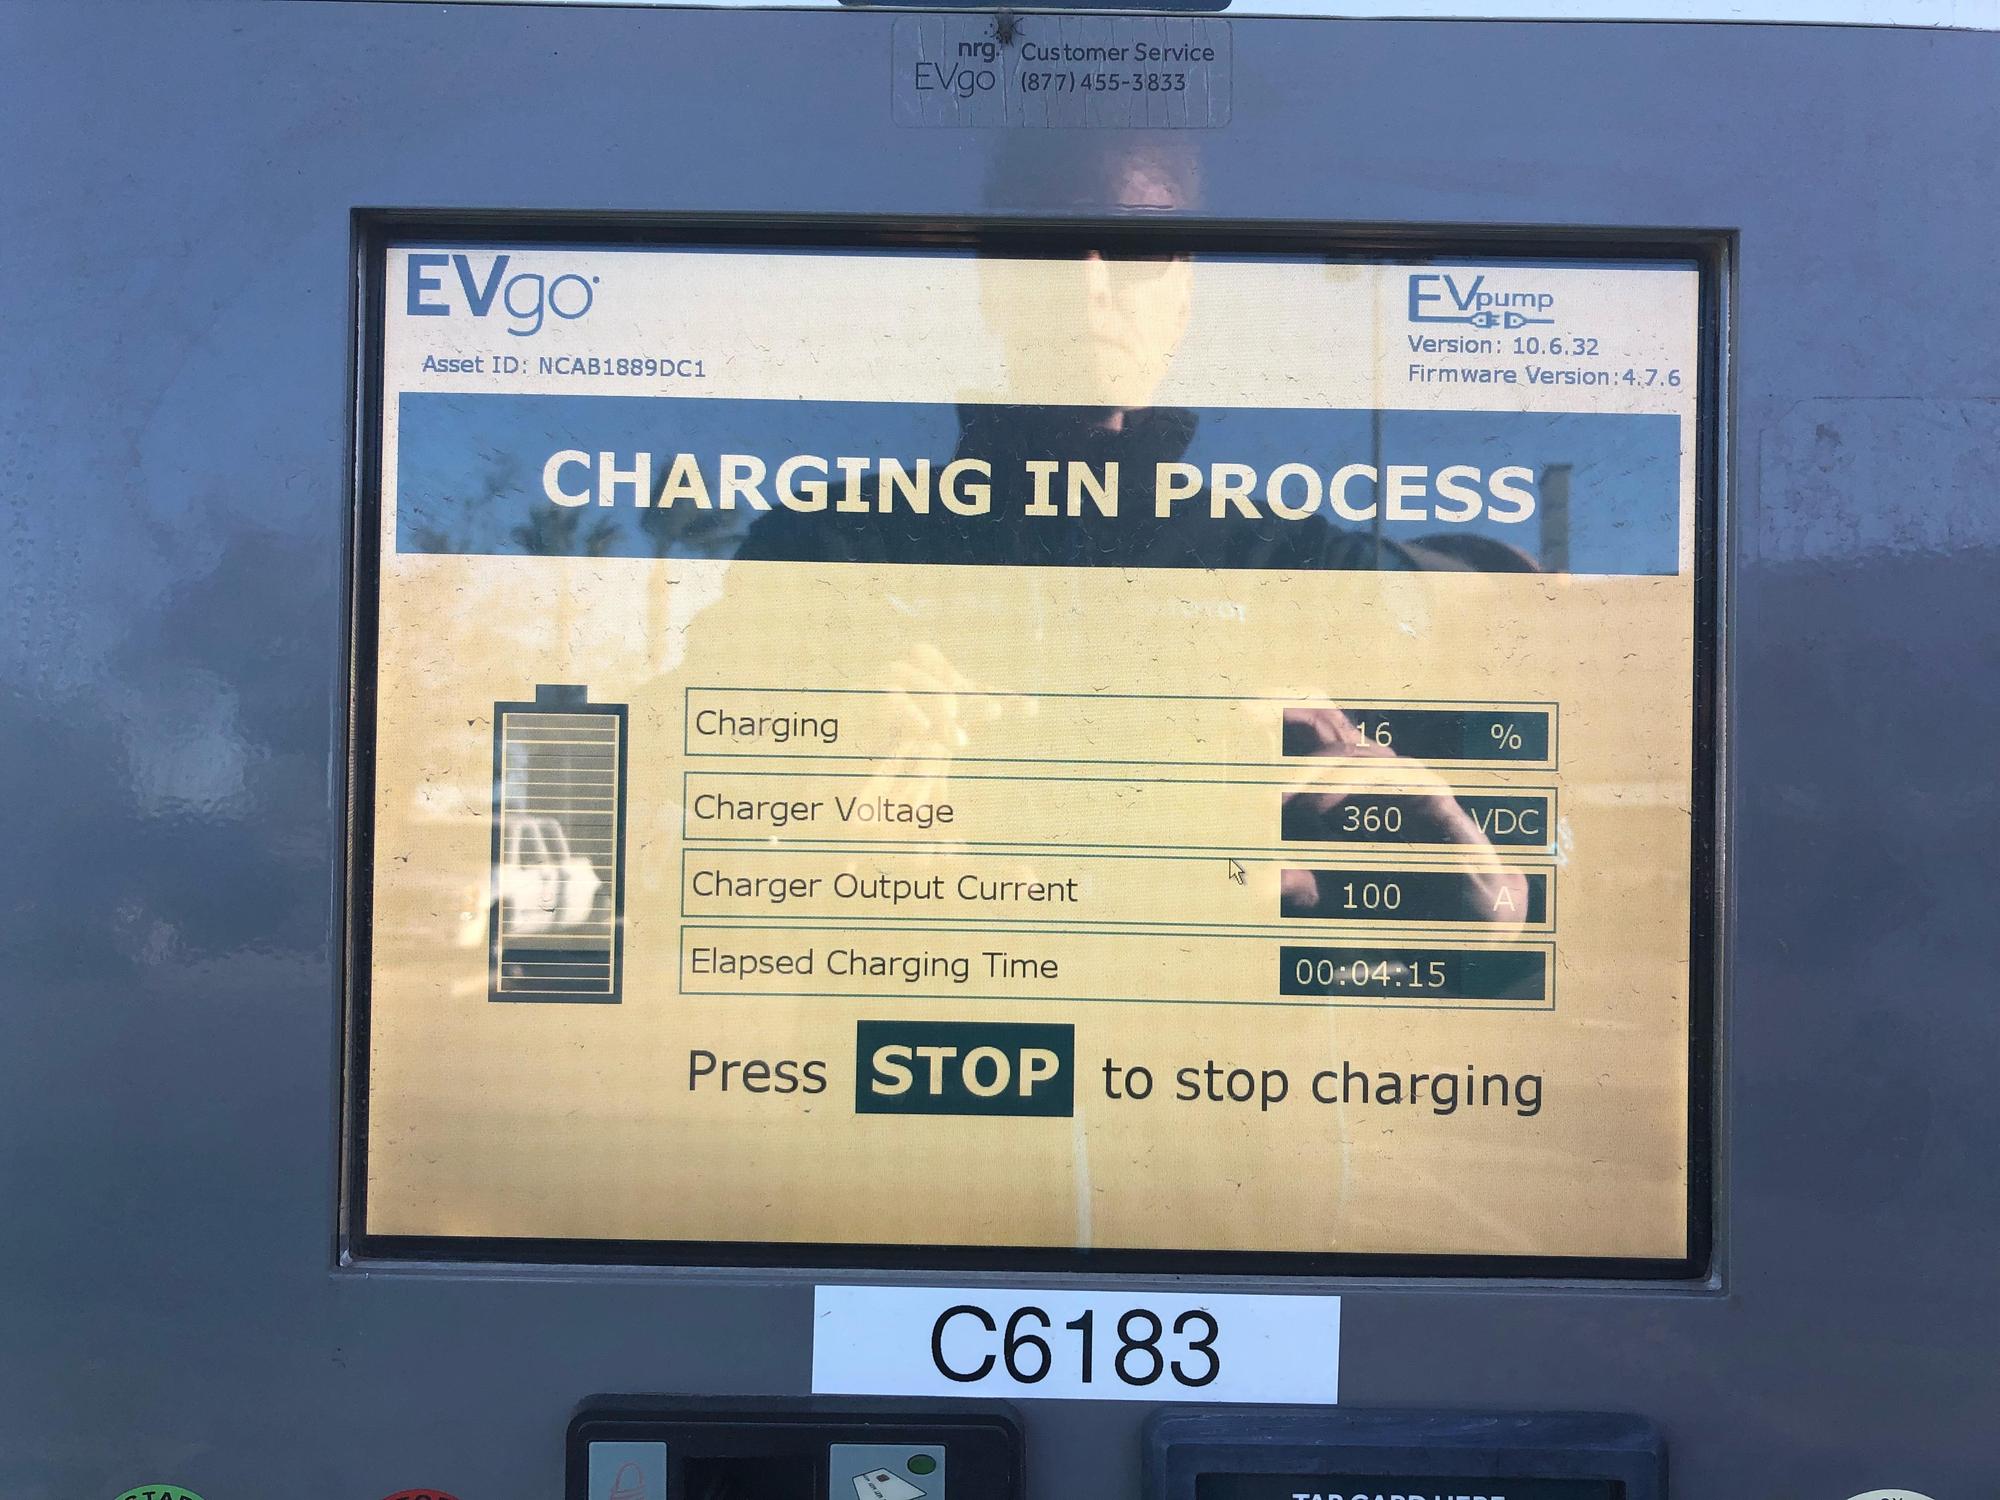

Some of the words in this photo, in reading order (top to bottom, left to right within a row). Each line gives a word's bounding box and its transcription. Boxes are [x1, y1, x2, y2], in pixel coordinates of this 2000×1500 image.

[1021, 43, 1129, 62] Customer
[1134, 43, 1215, 62] Service
[914, 62, 996, 98] EVgo
[1021, 72, 1075, 93] (877)
[1080, 73, 1186, 92] 455-3833
[406, 253, 600, 337] EVgo
[1407, 335, 1502, 354] Version:
[1513, 337, 1600, 356] 10.6.32
[422, 355, 485, 374] Asset
[492, 356, 528, 375] ID:
[539, 356, 706, 378] NCAB1889DC1
[1408, 364, 1518, 384] Firmware
[542, 449, 992, 517] CHARGING
[1024, 460, 1119, 518] IN
[1154, 462, 1537, 524] PROCESS
[695, 709, 839, 743] Charging
[1355, 721, 1393, 747] 16
[1490, 723, 1522, 750] %
[694, 794, 824, 827] Charger
[834, 796, 954, 829] Voltage
[1342, 805, 1402, 833] 360
[1470, 807, 1540, 835] VDC
[692, 870, 822, 904] Charger
[833, 872, 945, 905] Output
[957, 875, 1079, 902] Current
[1342, 882, 1401, 910] 100
[1492, 886, 1516, 912] A
[691, 947, 814, 981] Elapsed
[826, 949, 970, 984] Charging
[982, 951, 1059, 979] Time
[1295, 958, 1446, 988] 00:04:15
[688, 1049, 828, 1094] Press
[871, 1044, 1061, 1097] STOP
[1101, 1058, 1154, 1100] to
[1175, 1060, 1290, 1112] stop
[1311, 1061, 1543, 1117] charging
[931, 1304, 1221, 1388] C6183
